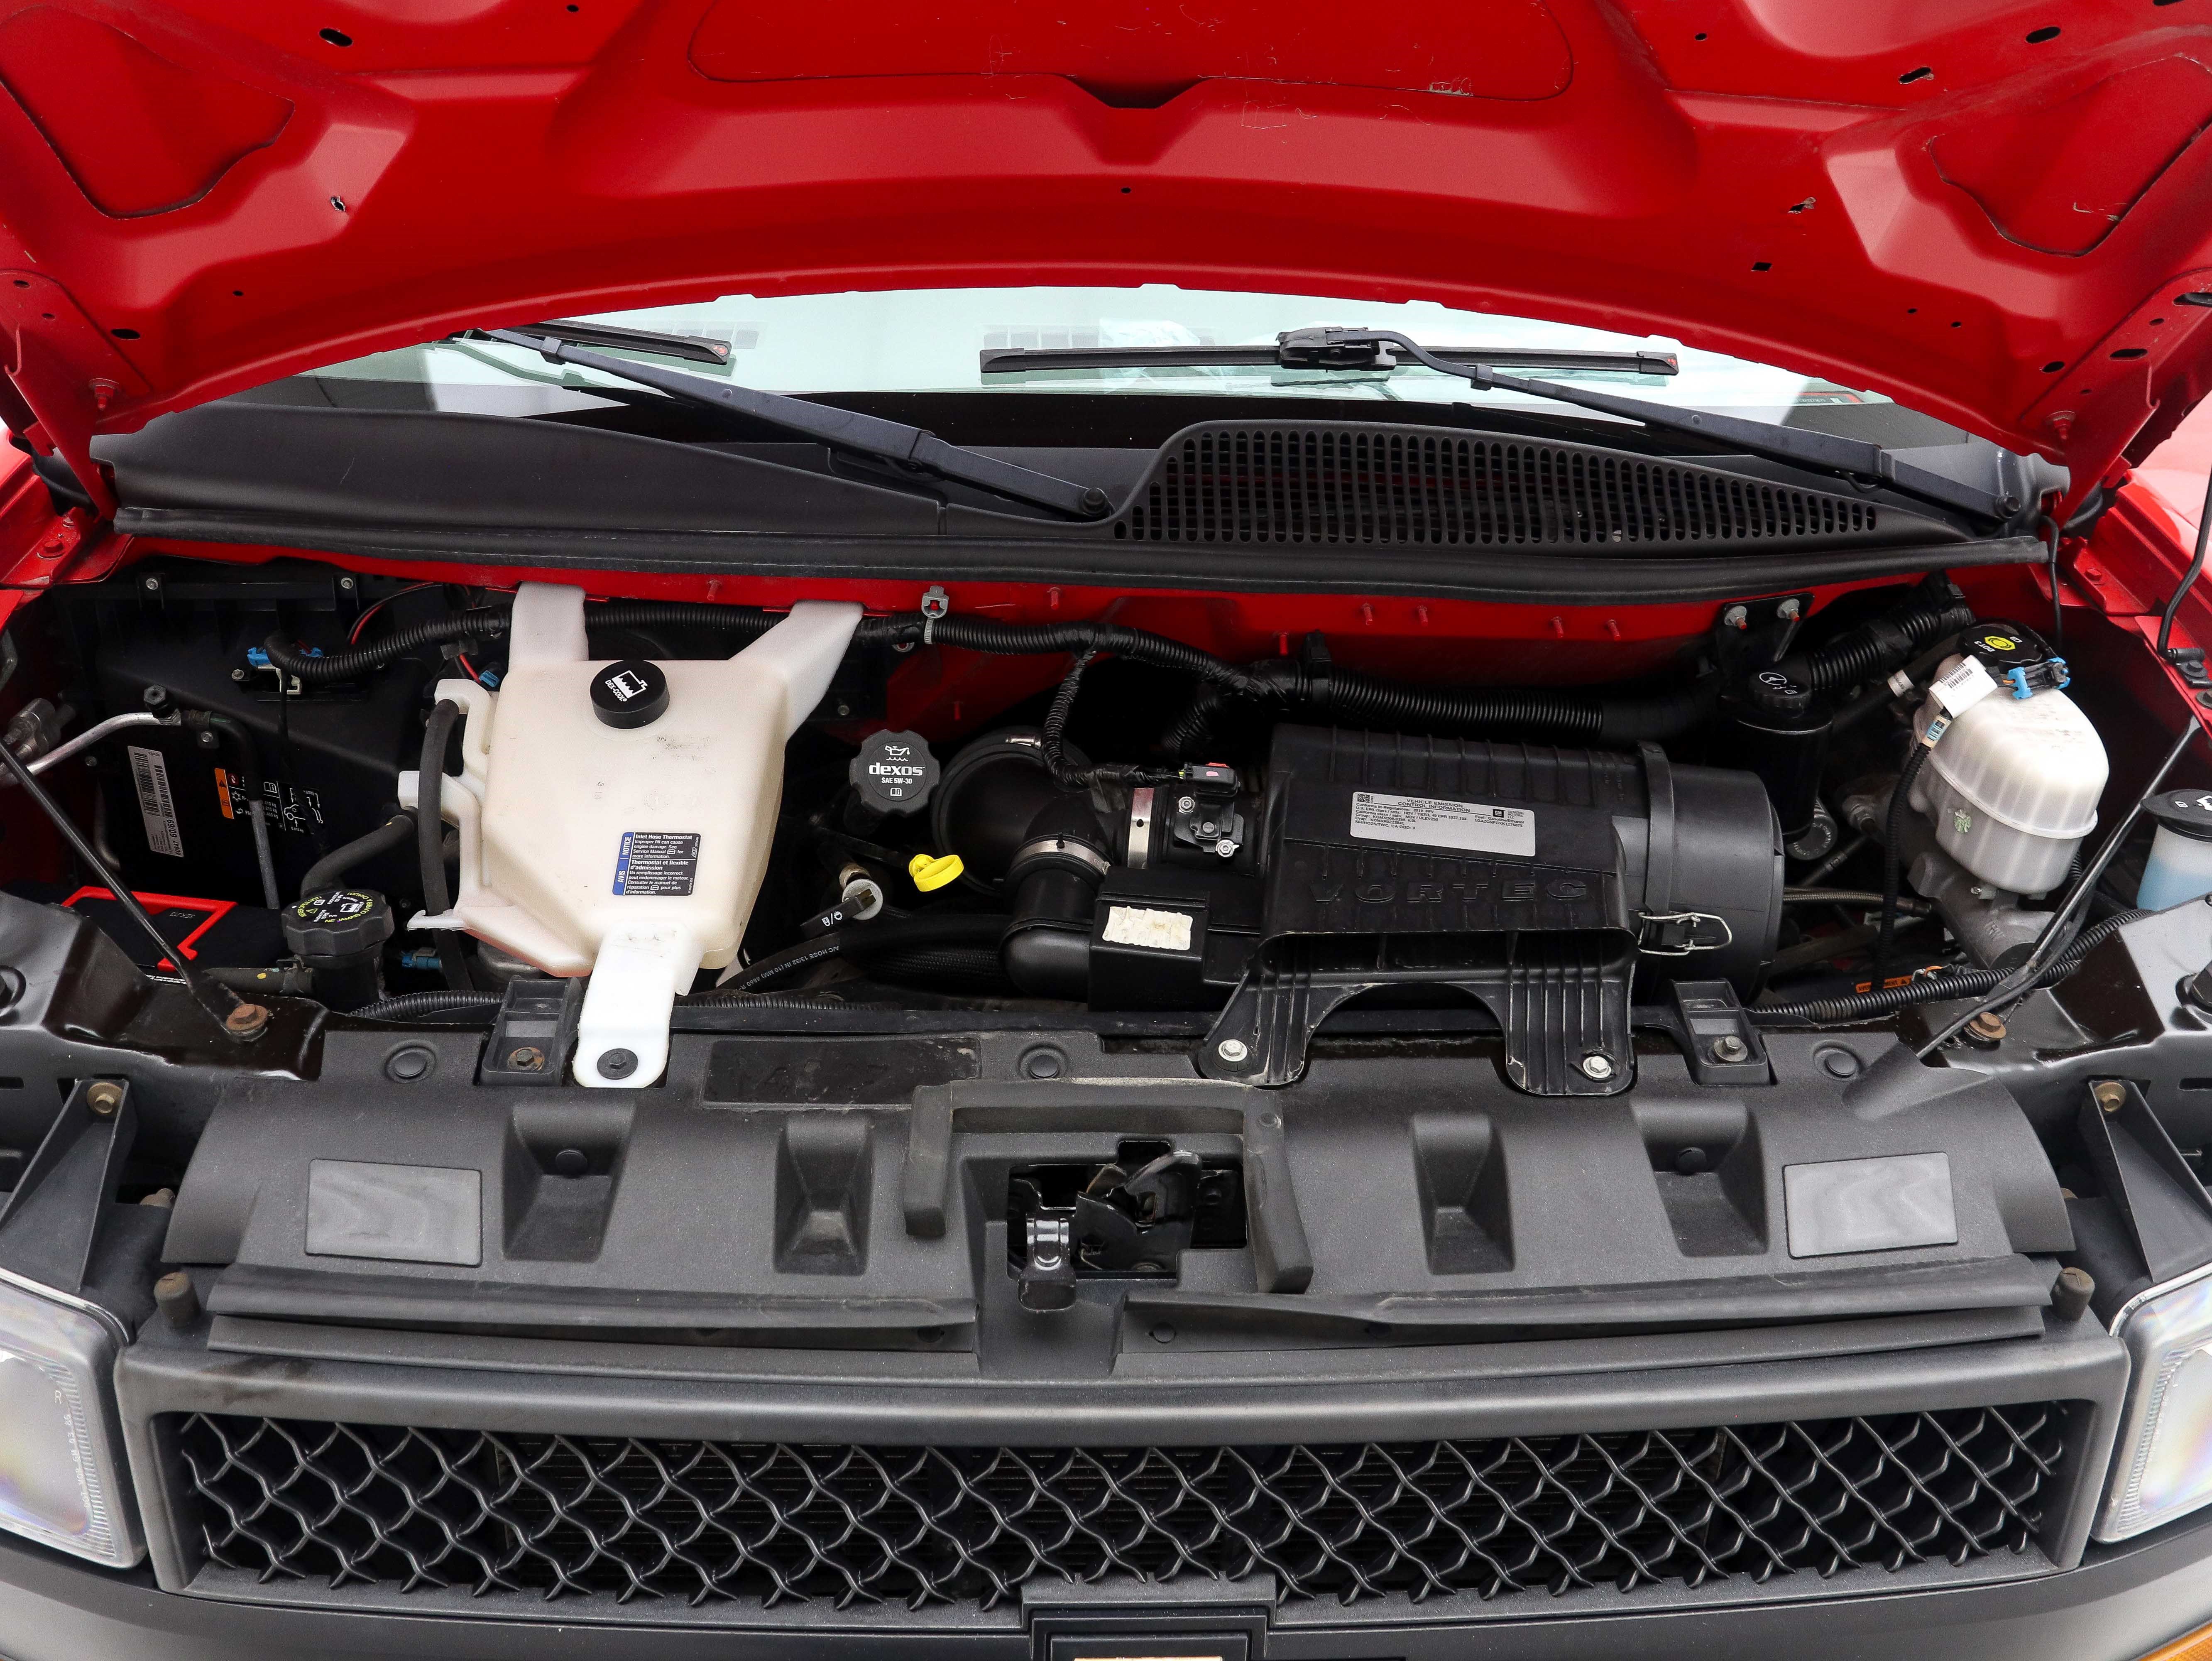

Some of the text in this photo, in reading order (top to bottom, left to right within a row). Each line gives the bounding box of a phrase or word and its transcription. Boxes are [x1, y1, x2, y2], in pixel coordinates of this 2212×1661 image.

[166, 819, 177, 838] 60/69
[622, 836, 631, 855] NOTICE
[617, 870, 626, 883] AVIS
[1309, 879, 1588, 903] VORTEC
[336, 914, 362, 923] JAMAIS
[360, 901, 373, 914] OUVRIR
[809, 950, 828, 959] HOSE
[761, 970, 774, 979] MM)
[775, 964, 784, 973] (10
